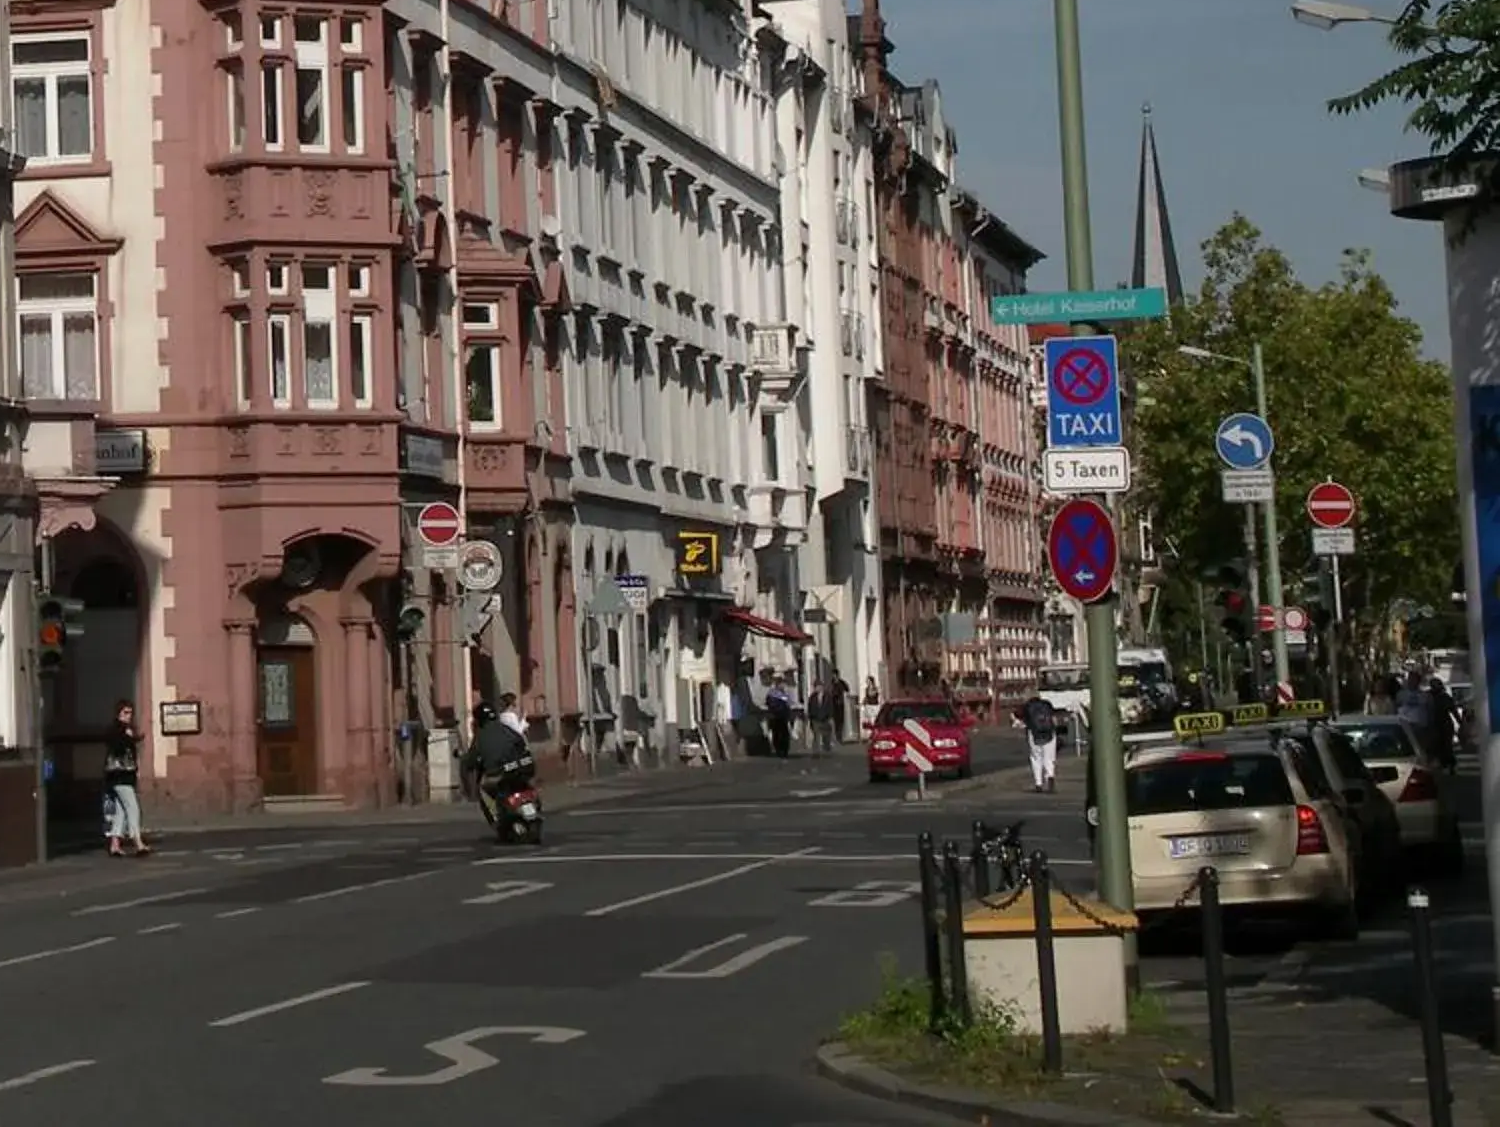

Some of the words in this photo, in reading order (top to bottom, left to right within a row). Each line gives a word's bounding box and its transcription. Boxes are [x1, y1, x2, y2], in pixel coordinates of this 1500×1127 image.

[1013, 299, 1054, 316] Hotel
[1056, 414, 1112, 436] TAXI
[1055, 461, 1065, 477] 5
[1070, 460, 1119, 477] Taxen
[1182, 717, 1220, 731] TAXI
